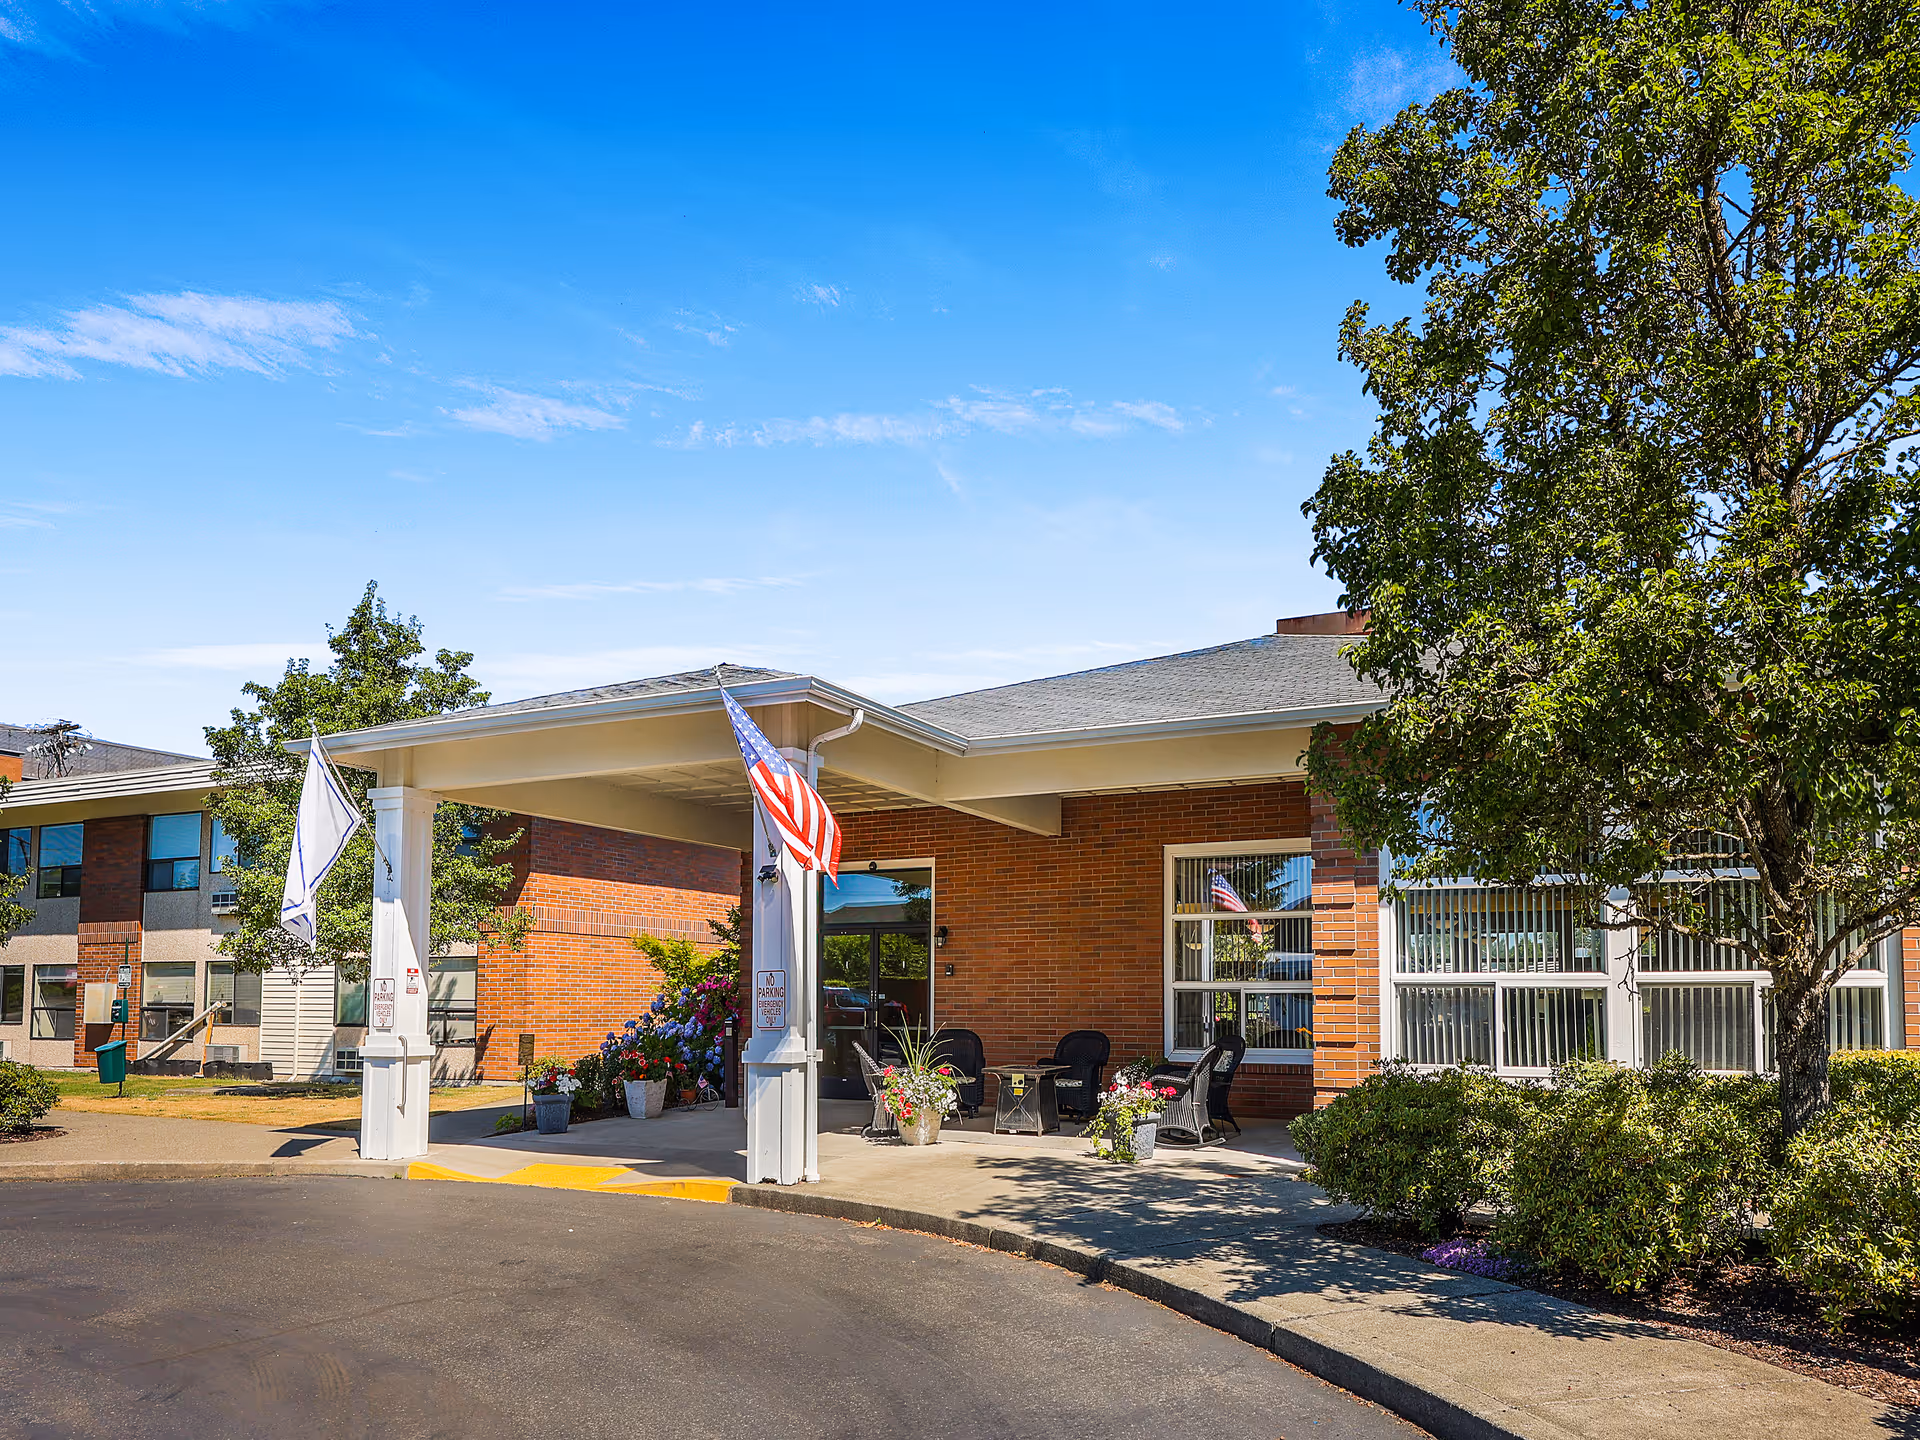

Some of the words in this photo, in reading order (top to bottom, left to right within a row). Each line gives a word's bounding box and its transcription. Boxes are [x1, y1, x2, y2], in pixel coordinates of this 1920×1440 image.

[766, 976, 775, 987] NO
[381, 983, 388, 992] NO
[374, 992, 394, 1002] PARKING
[758, 987, 784, 998] PARKING
[759, 1000, 784, 1008] EMERGENCY
[761, 1008, 782, 1016] VEHICLES
